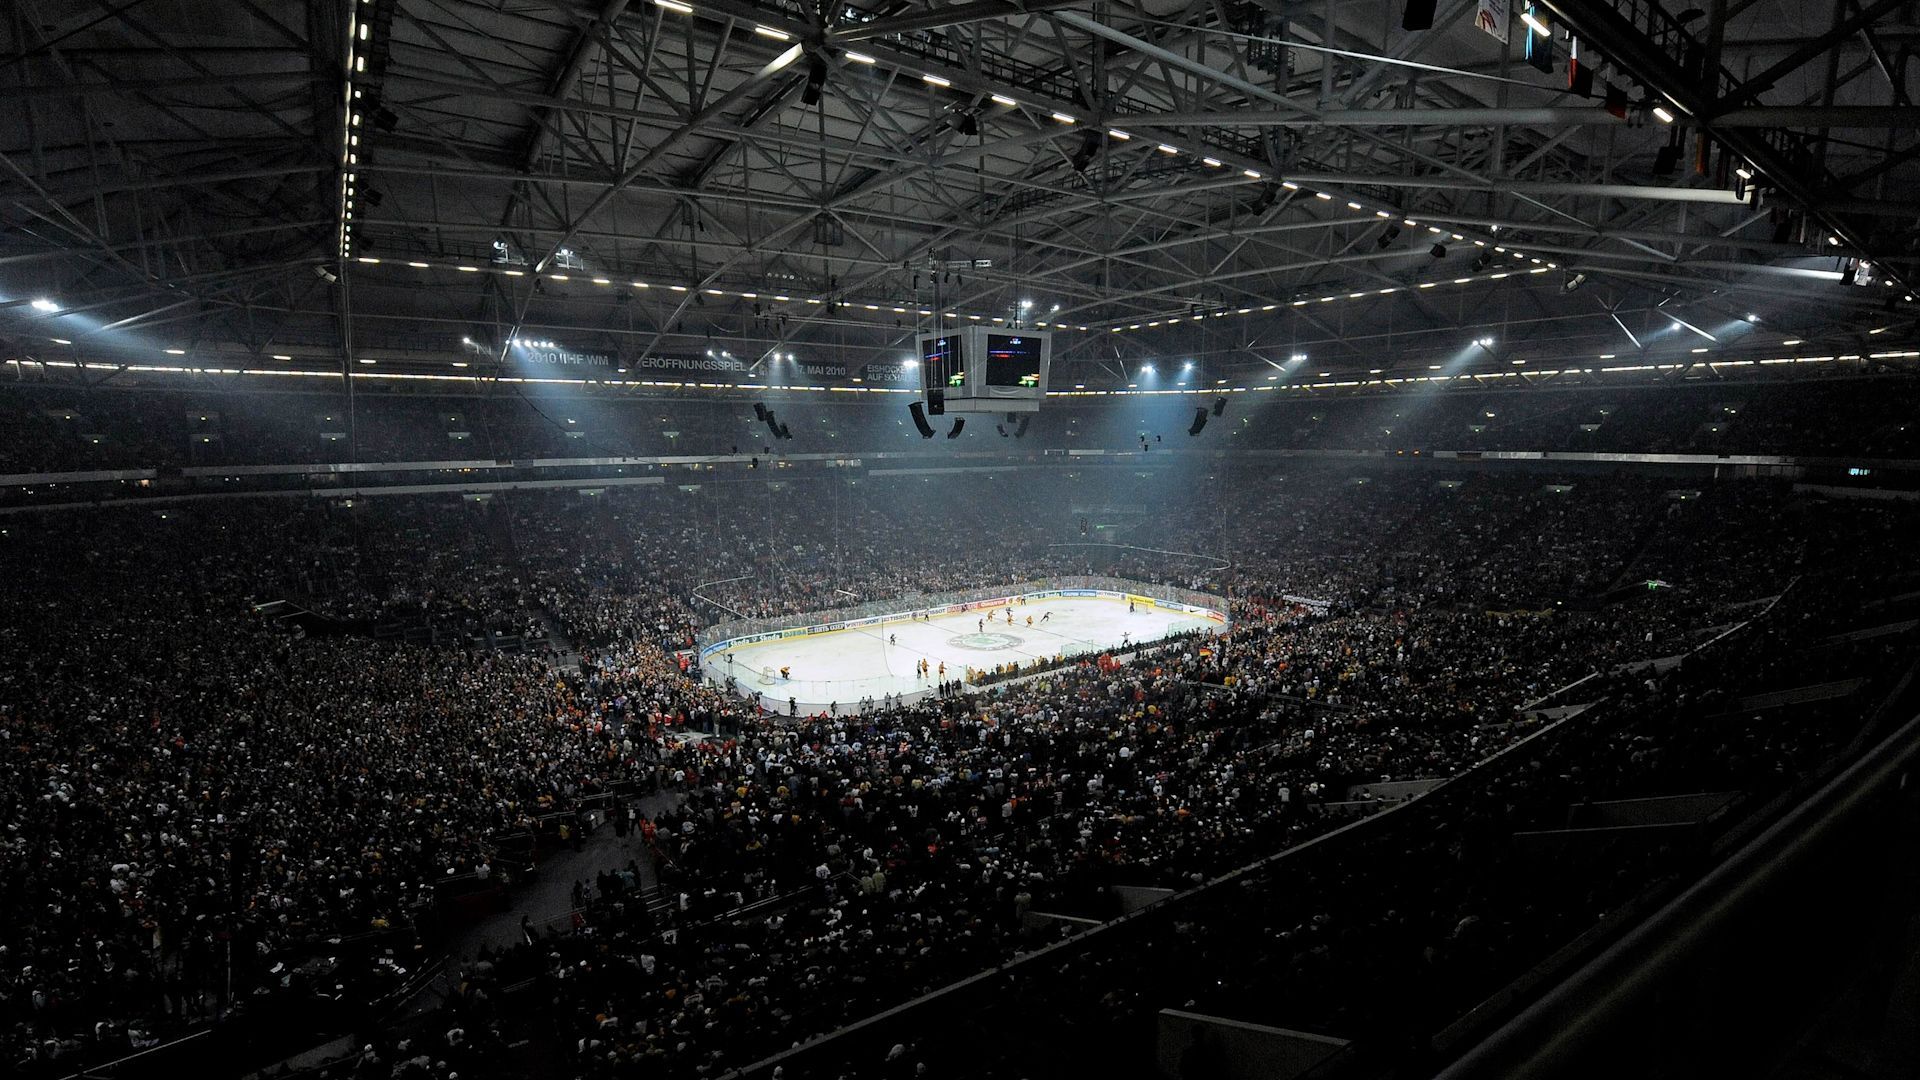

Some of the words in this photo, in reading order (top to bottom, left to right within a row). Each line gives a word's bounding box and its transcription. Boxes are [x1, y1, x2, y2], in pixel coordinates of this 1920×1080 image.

[527, 352, 557, 364] 2010
[559, 353, 585, 365] IIHF
[586, 355, 609, 366] WM
[807, 365, 824, 376] MAI
[825, 366, 846, 377] 2010
[867, 364, 909, 374] EISHOCKE
[867, 373, 884, 381] AUF
